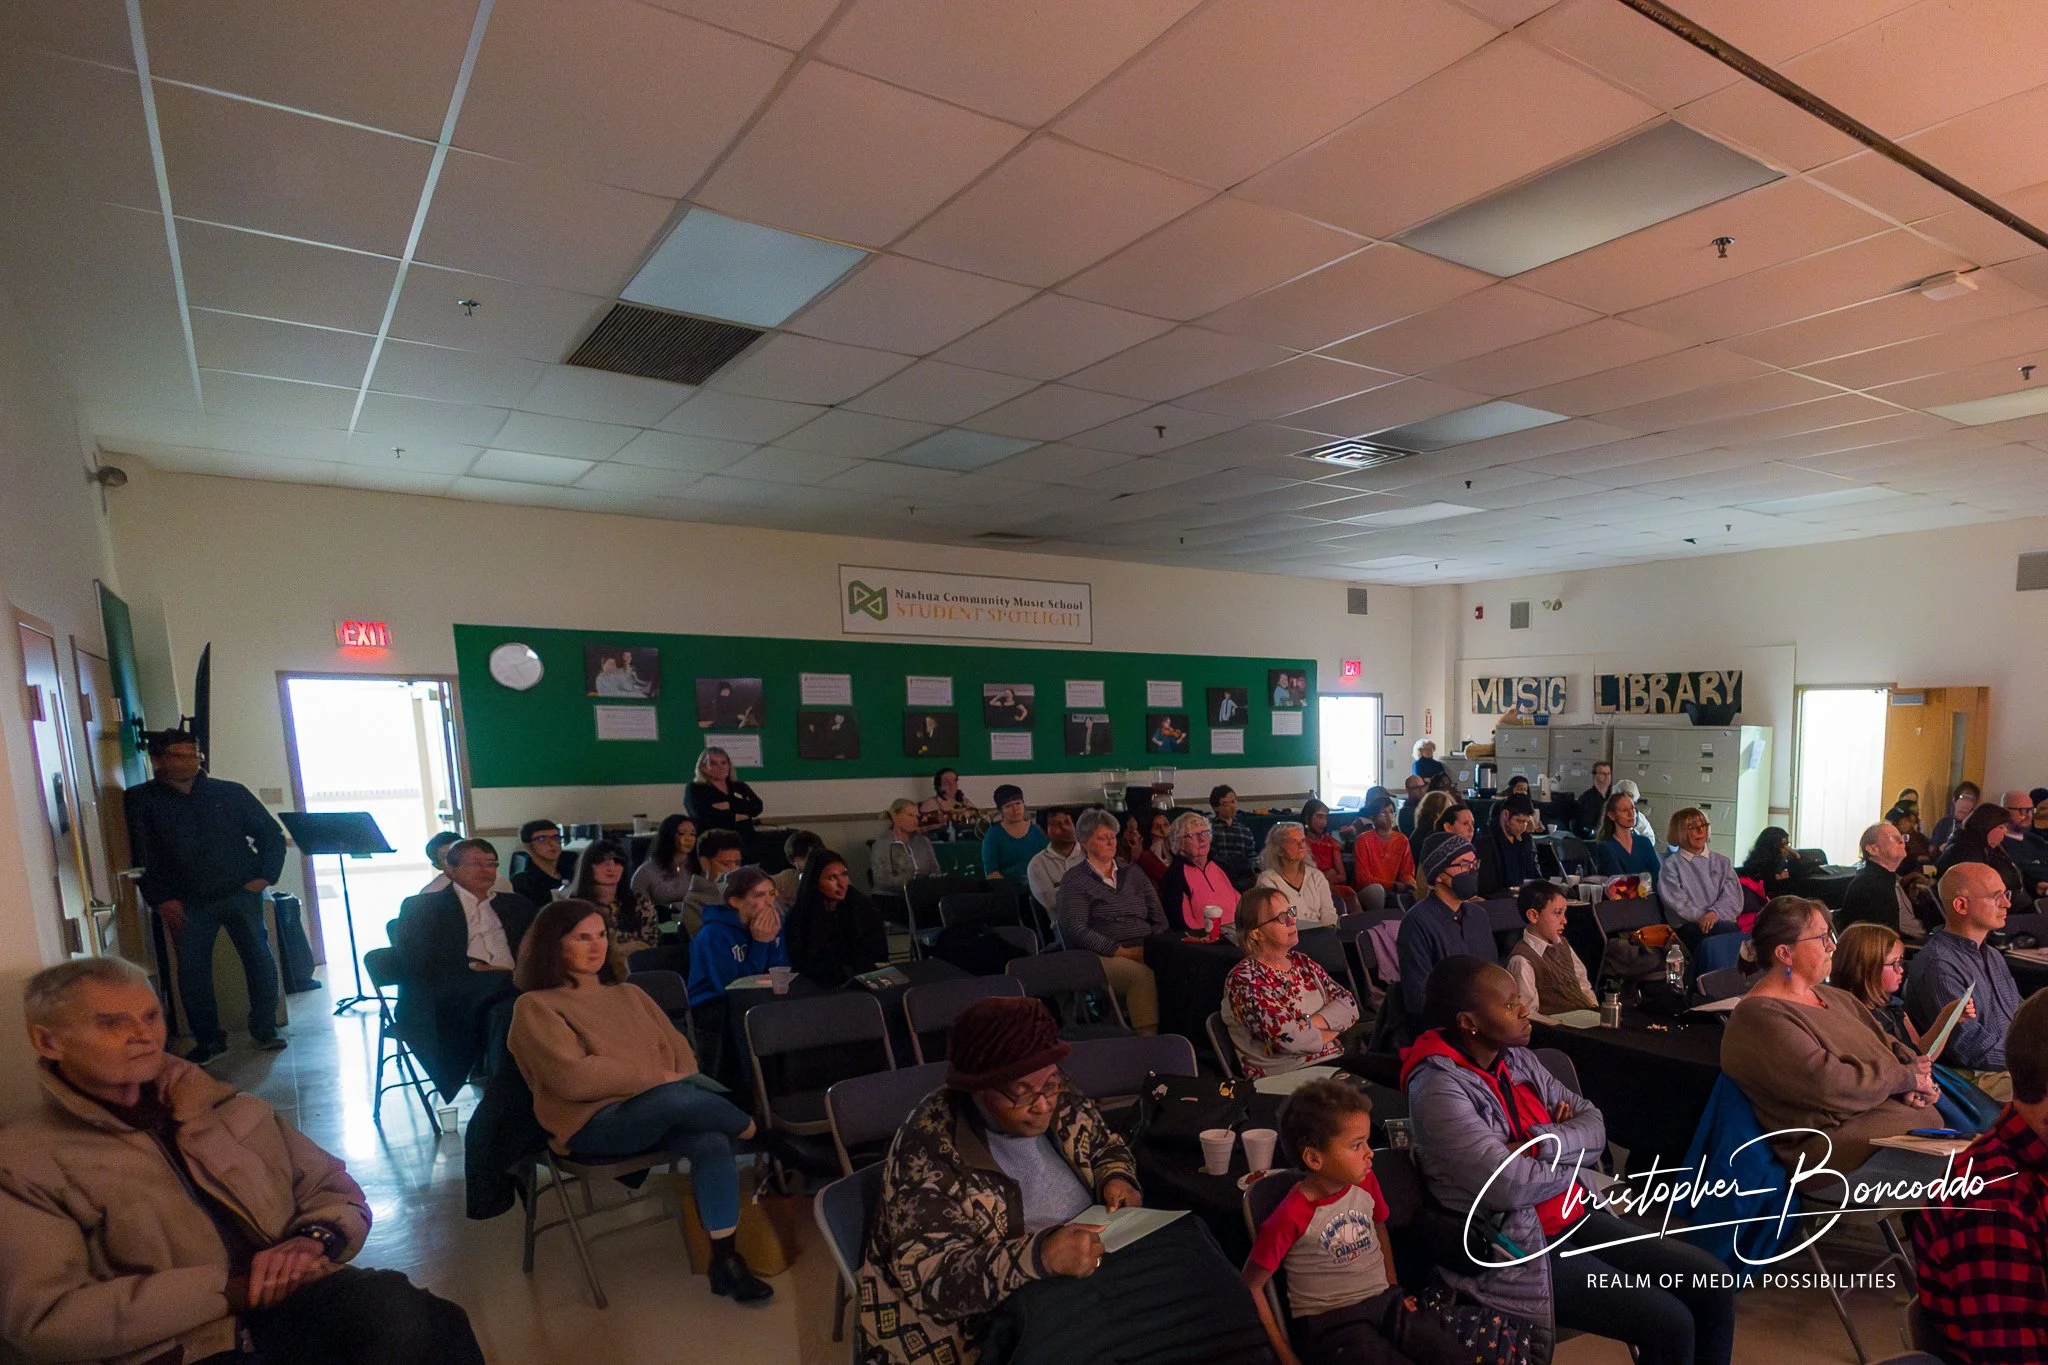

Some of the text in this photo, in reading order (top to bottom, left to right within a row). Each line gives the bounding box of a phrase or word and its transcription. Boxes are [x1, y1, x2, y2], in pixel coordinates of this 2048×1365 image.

[895, 588, 1083, 610] Nashua Community Music School
[896, 602, 1081, 626] STUDENT SPOTLIGHT
[342, 621, 388, 646] EXIT
[1472, 671, 1742, 714] MUSIC LIBRARY
